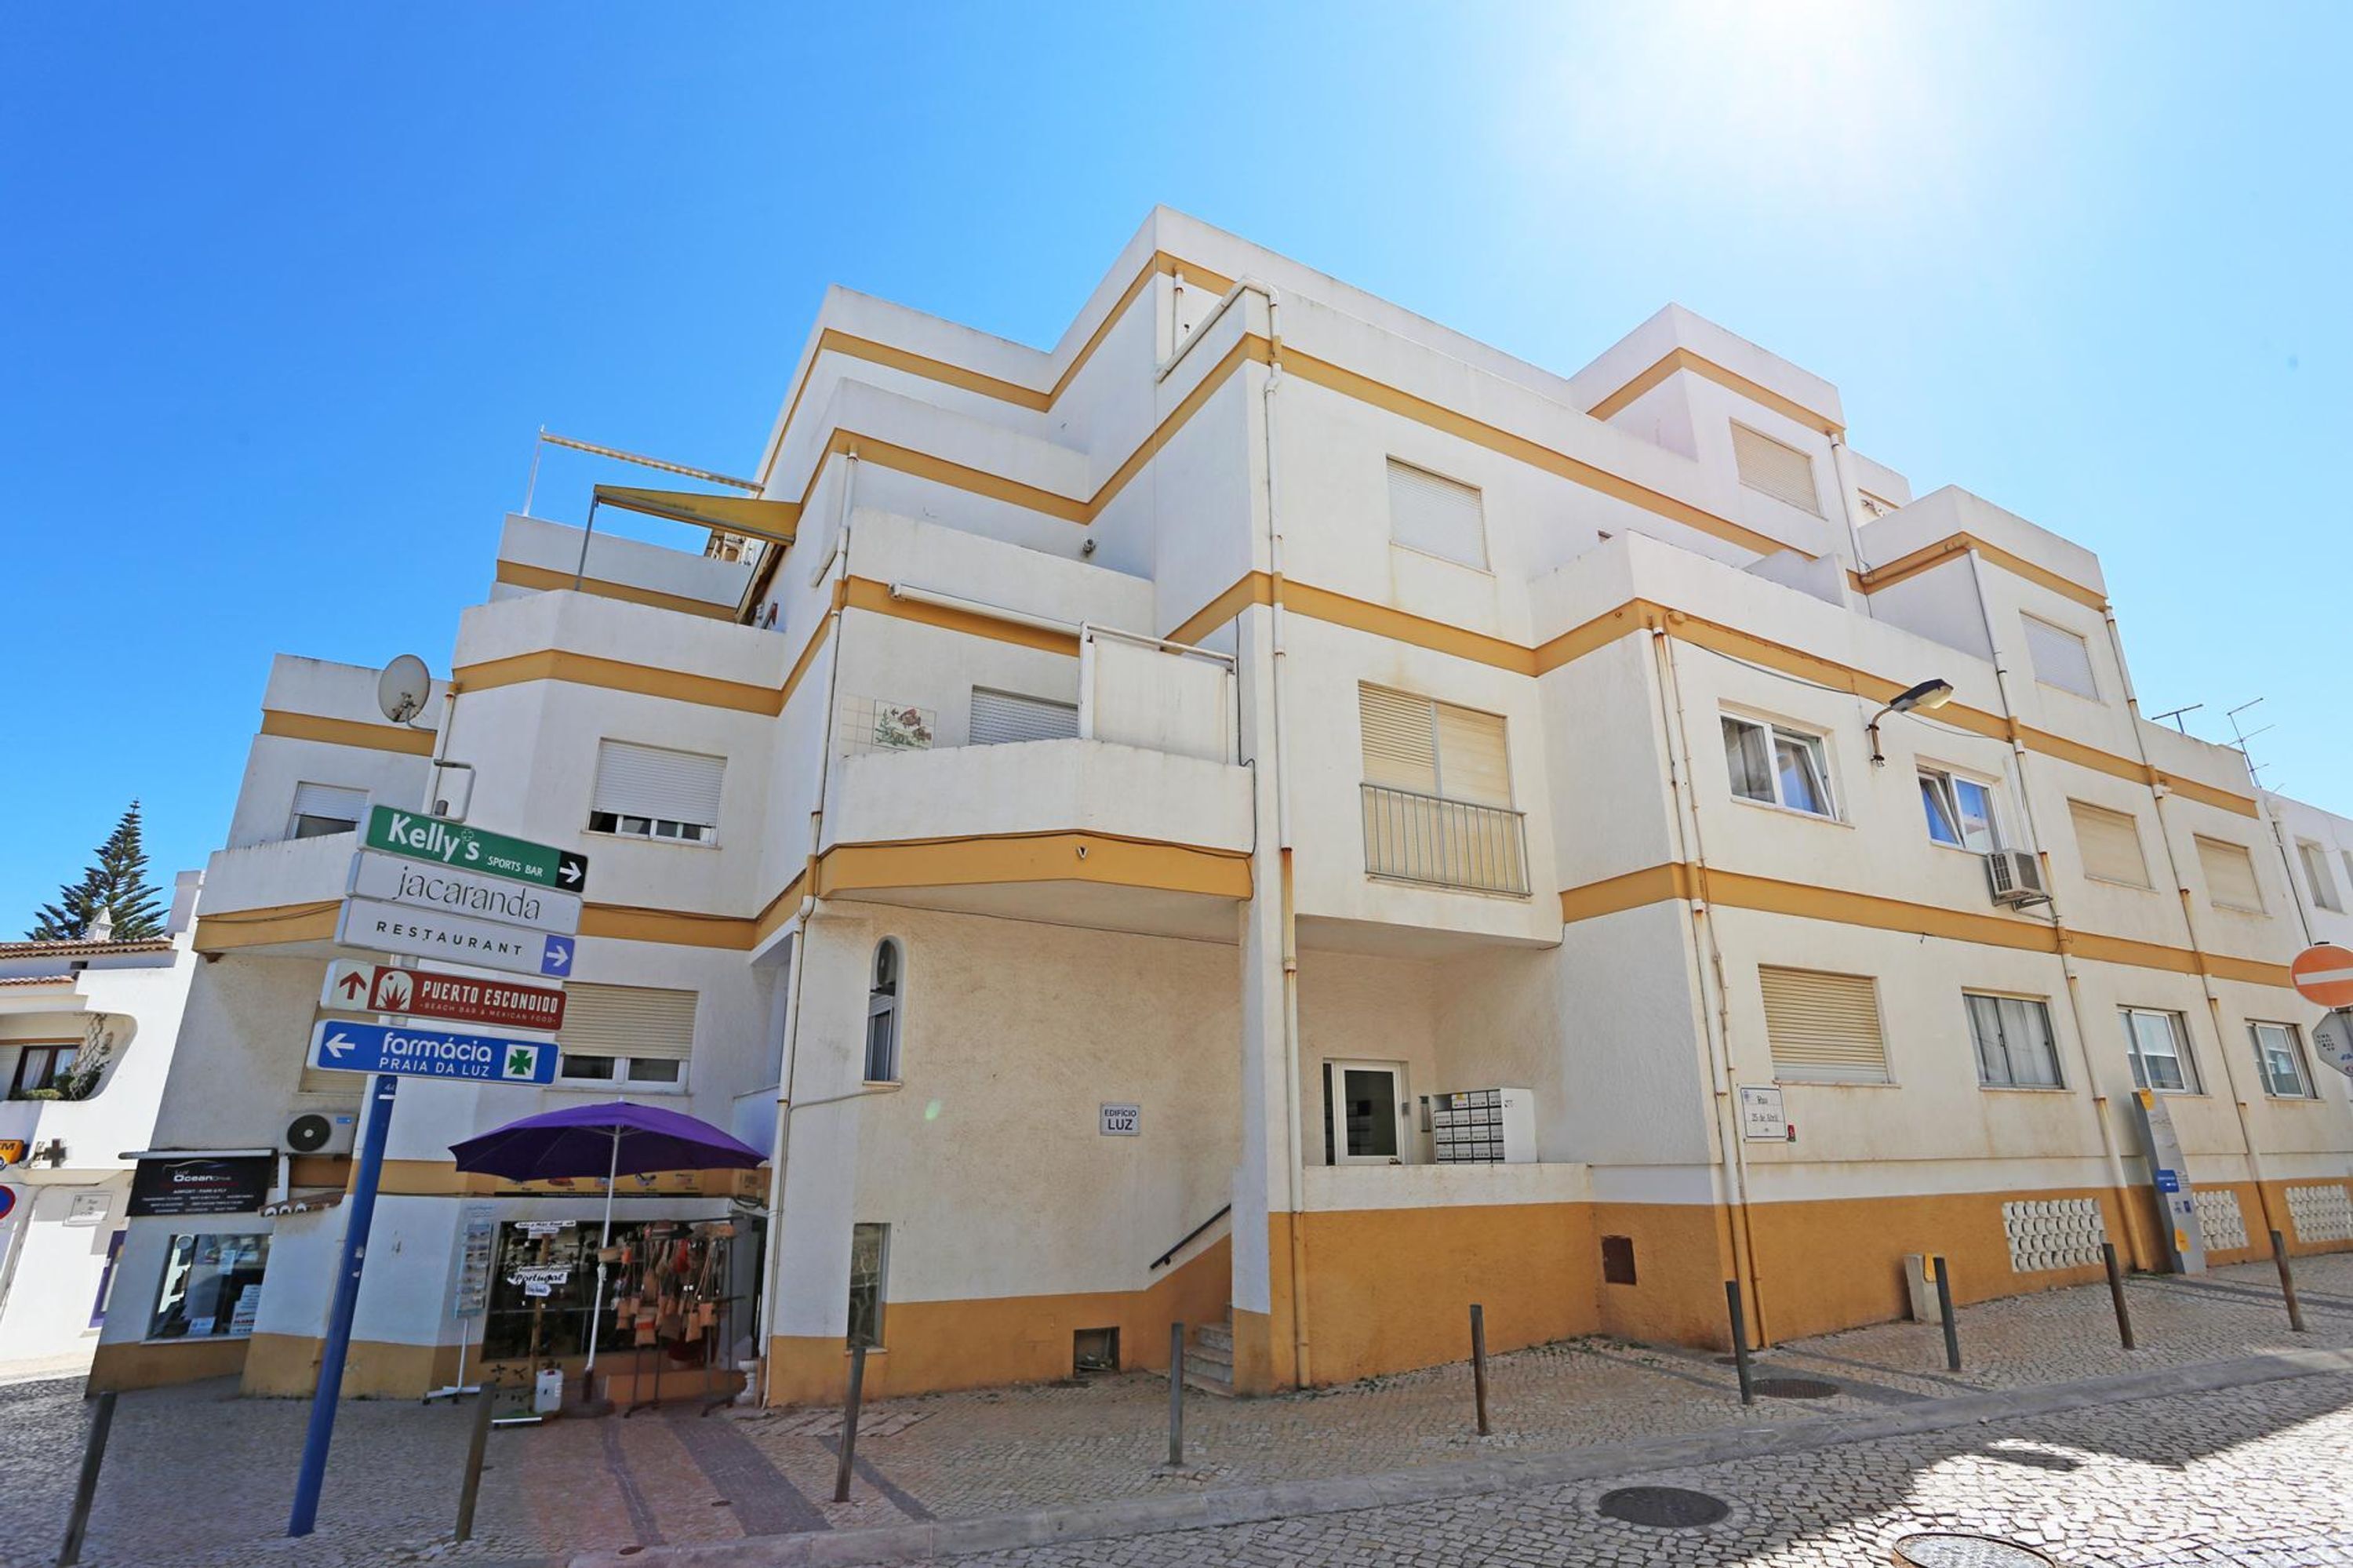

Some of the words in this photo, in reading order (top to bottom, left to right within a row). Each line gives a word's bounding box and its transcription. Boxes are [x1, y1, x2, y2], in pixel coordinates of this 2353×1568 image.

[387, 813, 480, 863] Kelly's
[486, 855, 522, 872] SPORTS
[524, 864, 544, 878] BAR
[391, 865, 541, 921] jacaranda
[376, 920, 523, 955] RESTAURANT
[421, 980, 479, 1004] PUERTO
[484, 988, 558, 1013] ESCONDIDO
[382, 1031, 493, 1063] farmácia
[378, 1057, 428, 1072] PRAIA
[435, 1061, 455, 1075] DA
[461, 1064, 490, 1078] LUZ
[1107, 1119, 1133, 1130] LUZ
